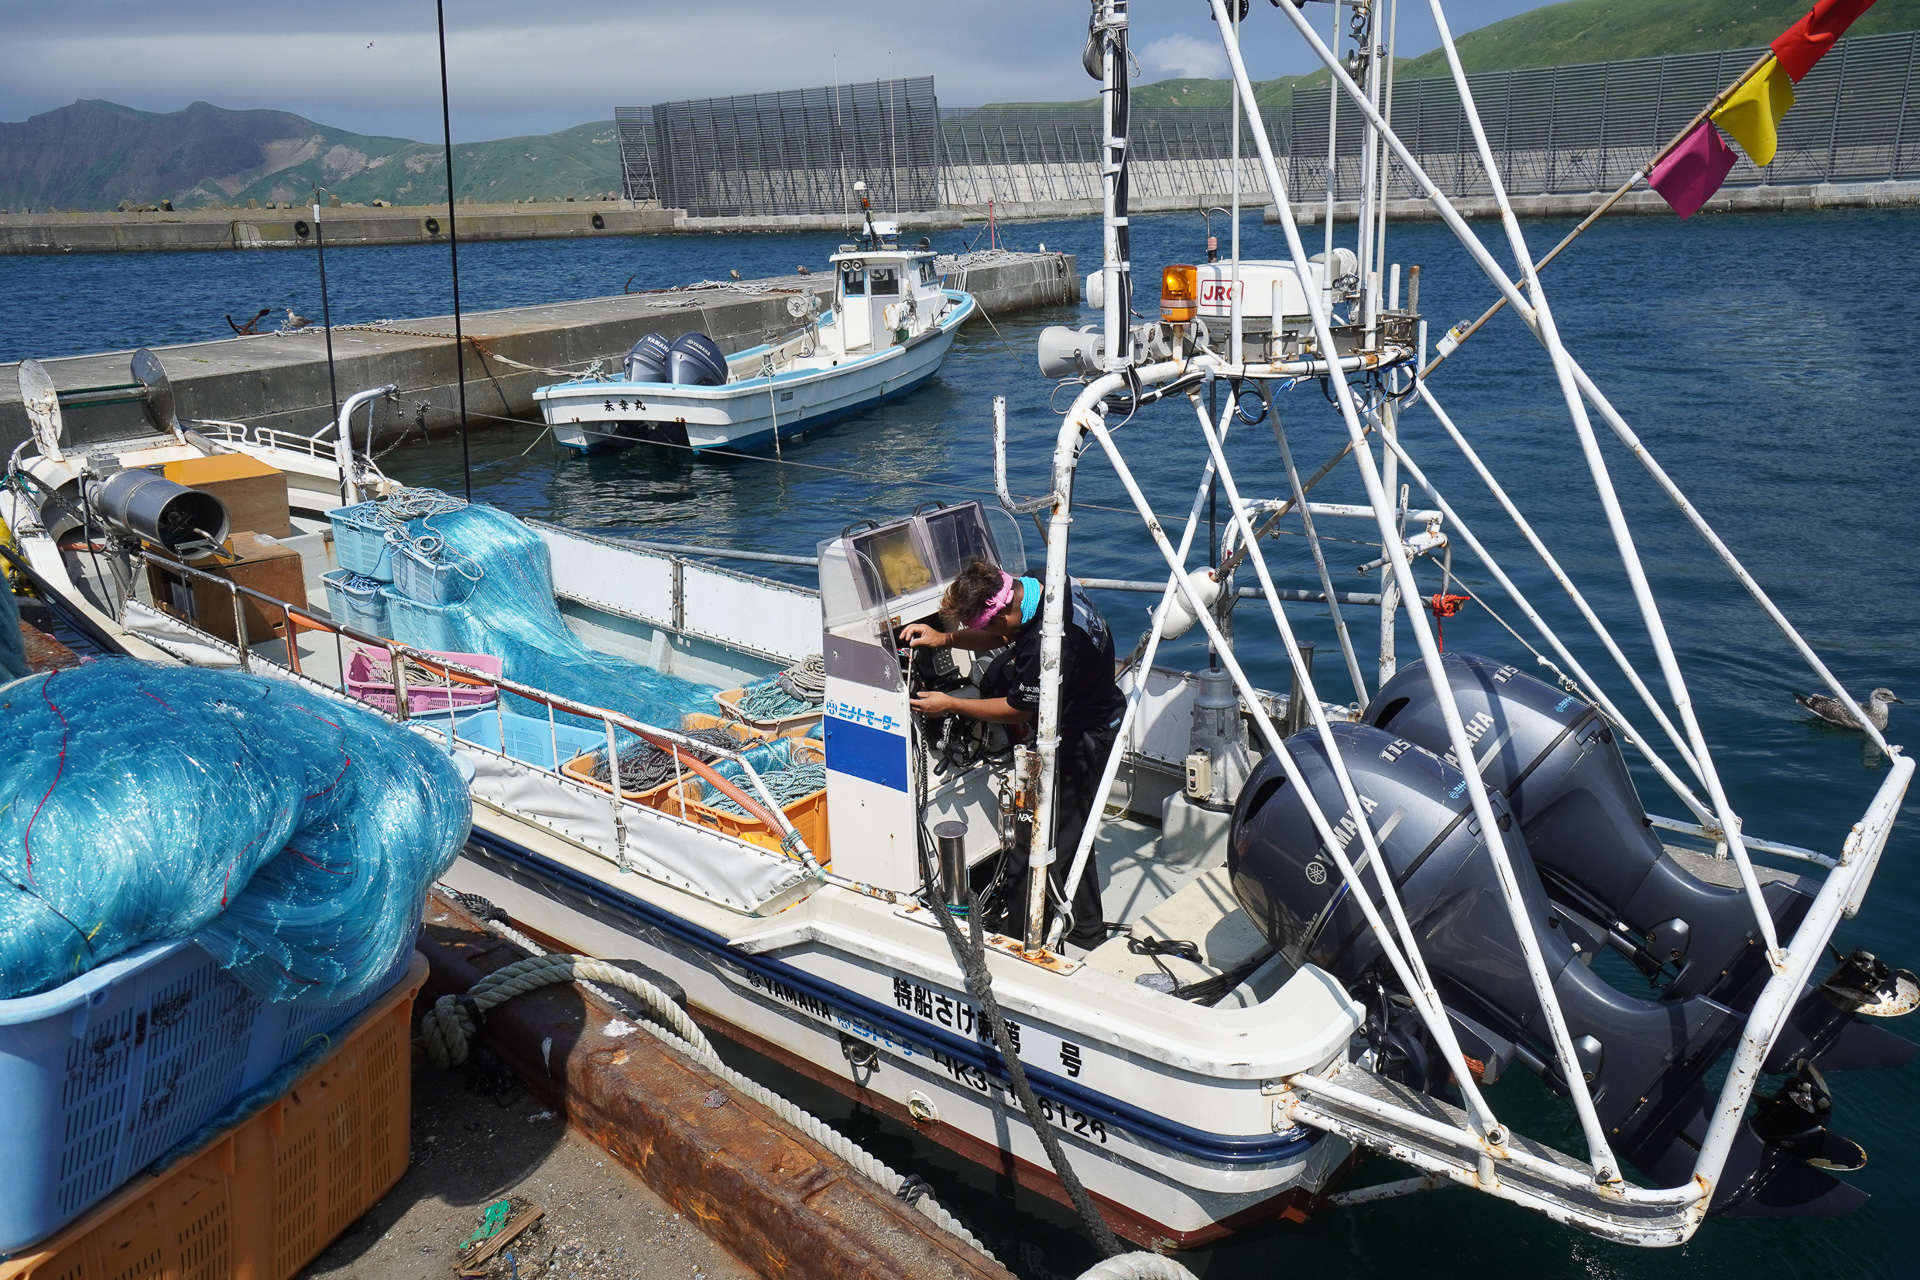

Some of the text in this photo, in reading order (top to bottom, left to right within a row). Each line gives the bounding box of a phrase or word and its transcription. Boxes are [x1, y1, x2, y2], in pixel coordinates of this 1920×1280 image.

[693, 342, 711, 356] YAMAHA
[1493, 665, 1519, 684] 115
[838, 702, 901, 730] ミナトモーター
[1380, 738, 1412, 763] 115
[1314, 794, 1379, 867] YMAA
[764, 977, 833, 1022] YAMAHA
[852, 1017, 924, 1057] ミナトモーター
[1059, 1040, 1082, 1078] 号
